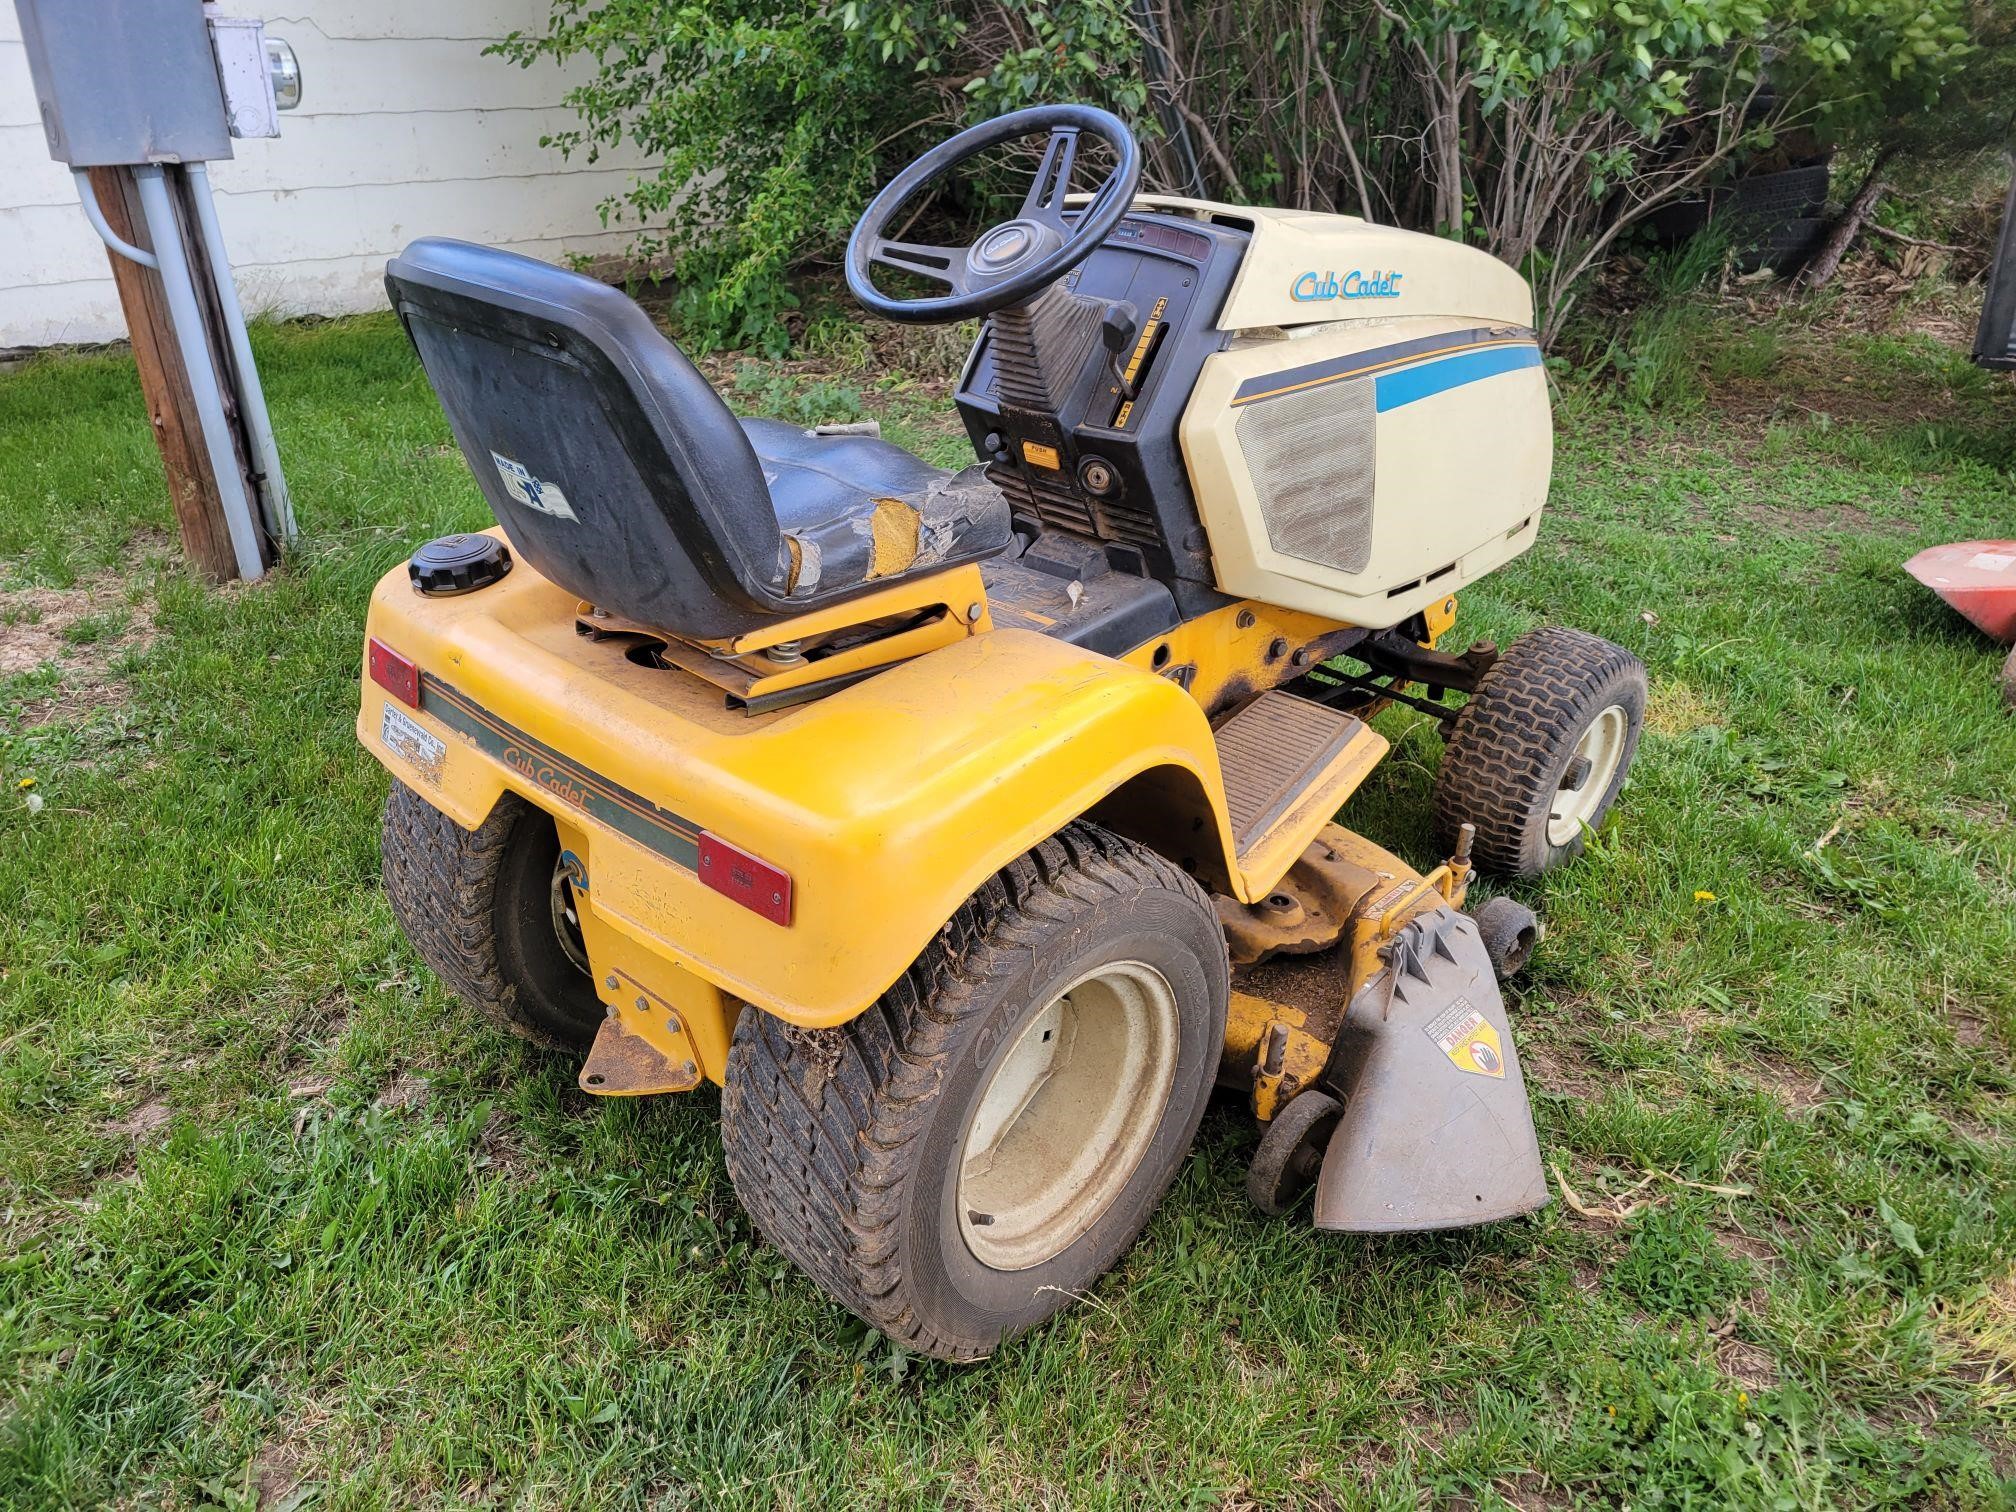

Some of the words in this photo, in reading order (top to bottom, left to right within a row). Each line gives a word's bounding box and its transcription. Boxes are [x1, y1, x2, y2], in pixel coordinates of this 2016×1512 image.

[1290, 271, 1338, 301] Cub
[1341, 270, 1402, 299] Cadet
[503, 747, 535, 778] Cub
[537, 767, 595, 812] Cadet
[974, 1000, 1020, 1069] Cub
[1445, 1017, 1479, 1047] DANGER
